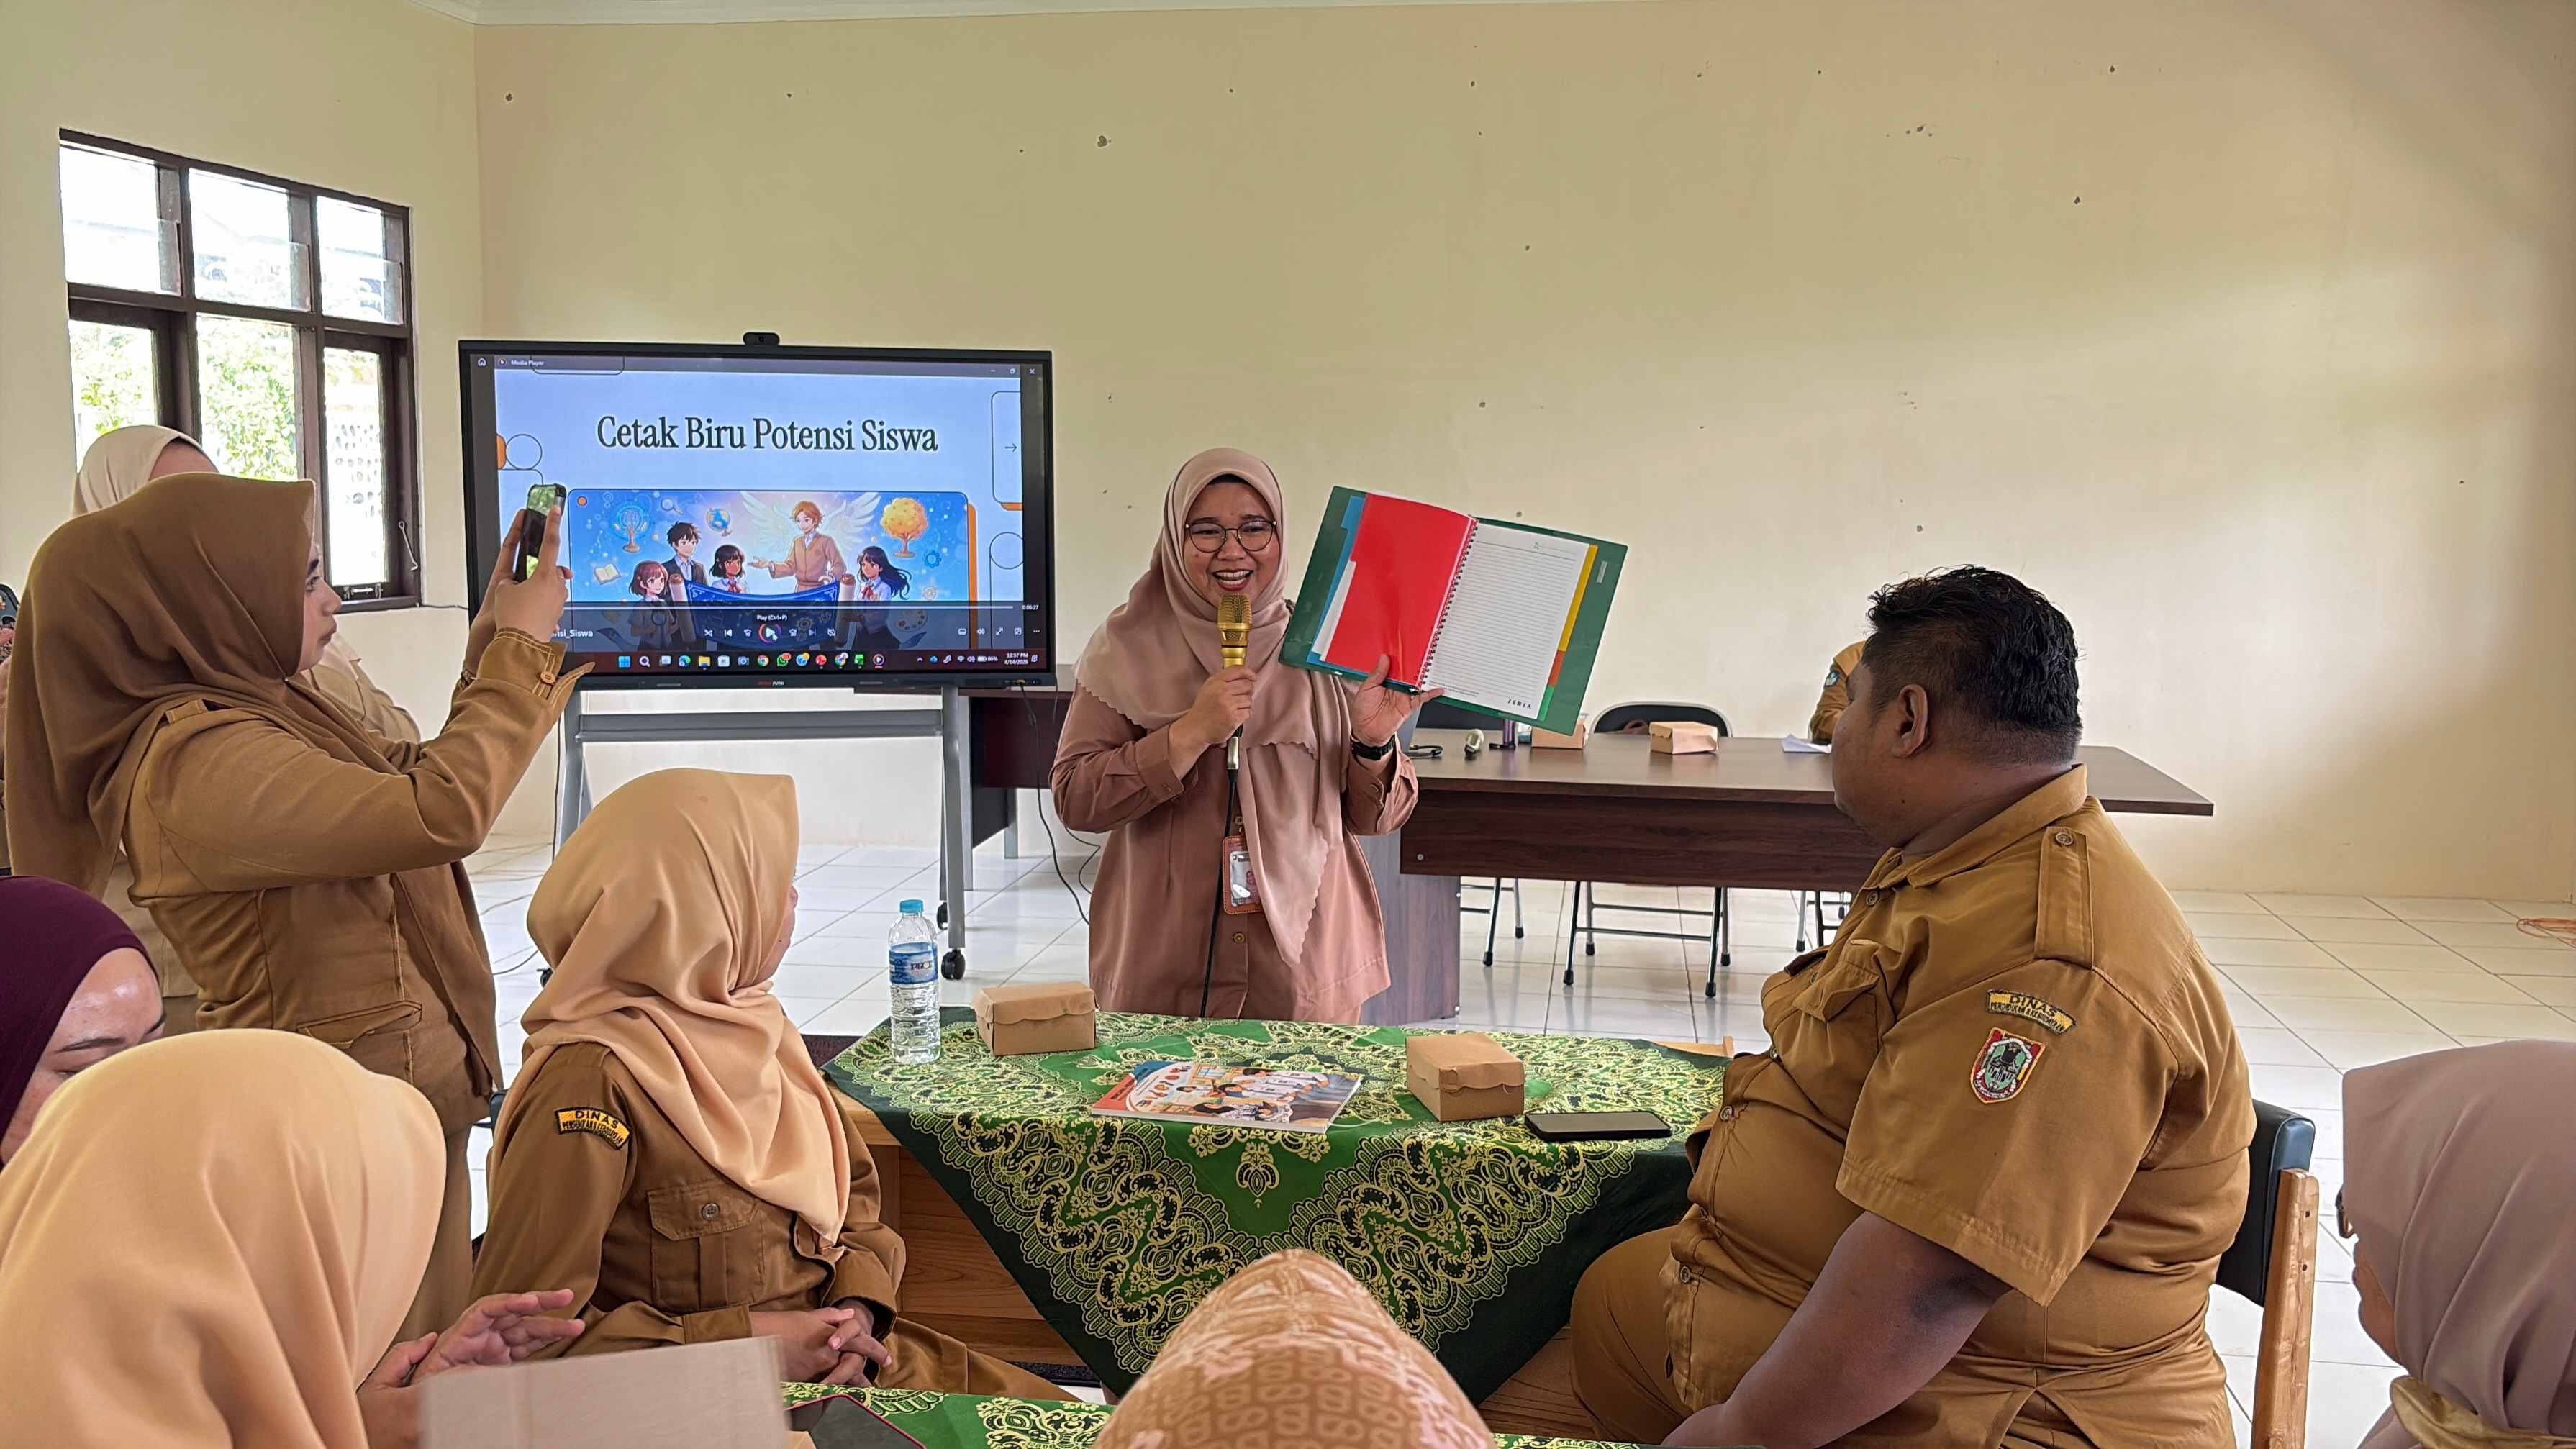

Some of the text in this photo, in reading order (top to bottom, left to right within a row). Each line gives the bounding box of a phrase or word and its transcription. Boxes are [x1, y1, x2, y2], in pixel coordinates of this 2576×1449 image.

[597, 416, 938, 451] Cetak Biru Potensi Siswa
[2010, 995, 2056, 1017] DINAS
[575, 1110, 619, 1129] DINAS
